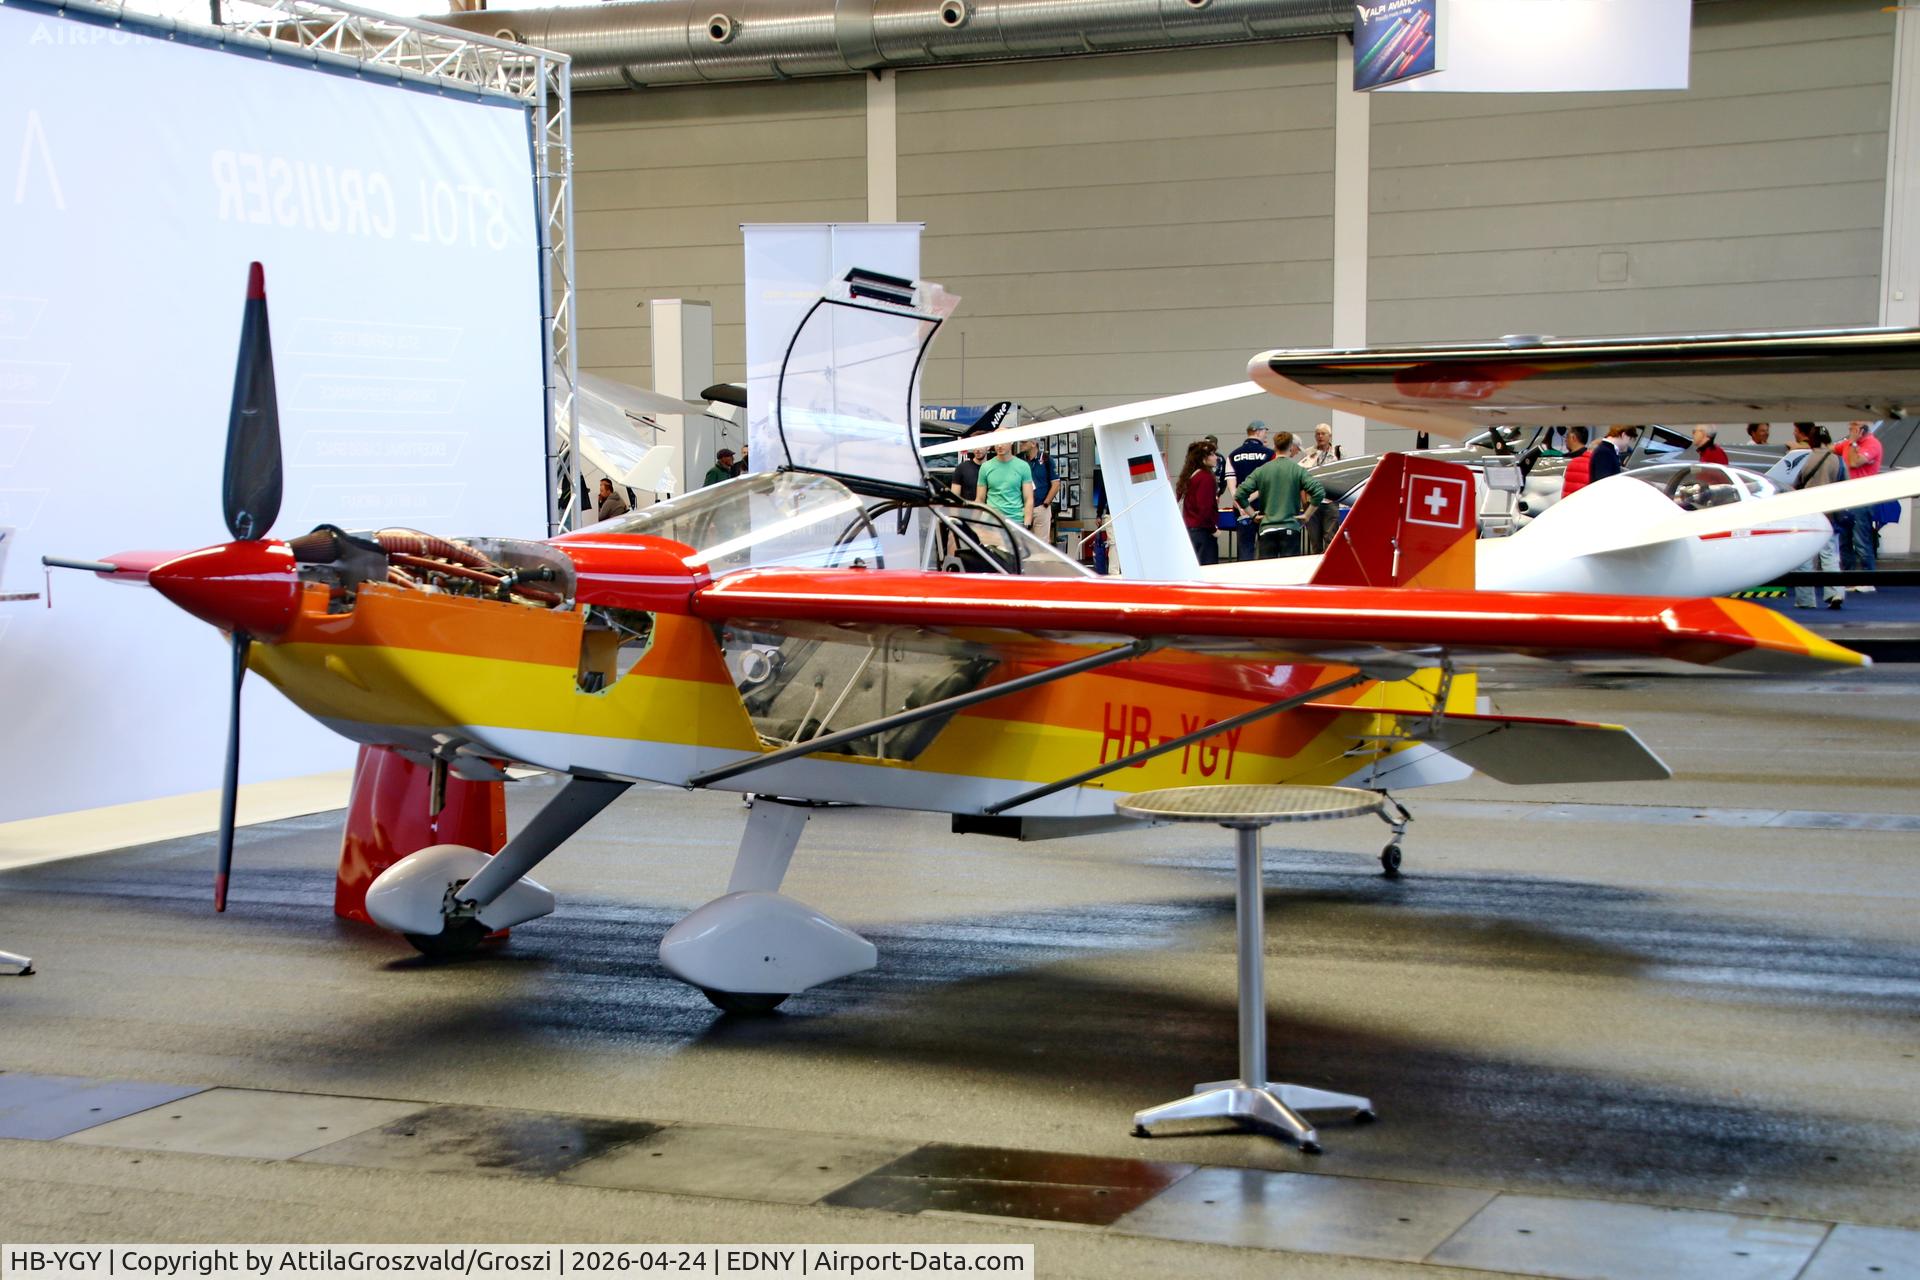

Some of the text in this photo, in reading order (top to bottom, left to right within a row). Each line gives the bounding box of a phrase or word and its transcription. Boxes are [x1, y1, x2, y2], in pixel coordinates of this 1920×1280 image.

[1370, 4, 1386, 17] ALPI
[920, 407, 957, 420] ion Art
[1234, 453, 1266, 462] CREW
[1099, 702, 1242, 780] HB-YGY
